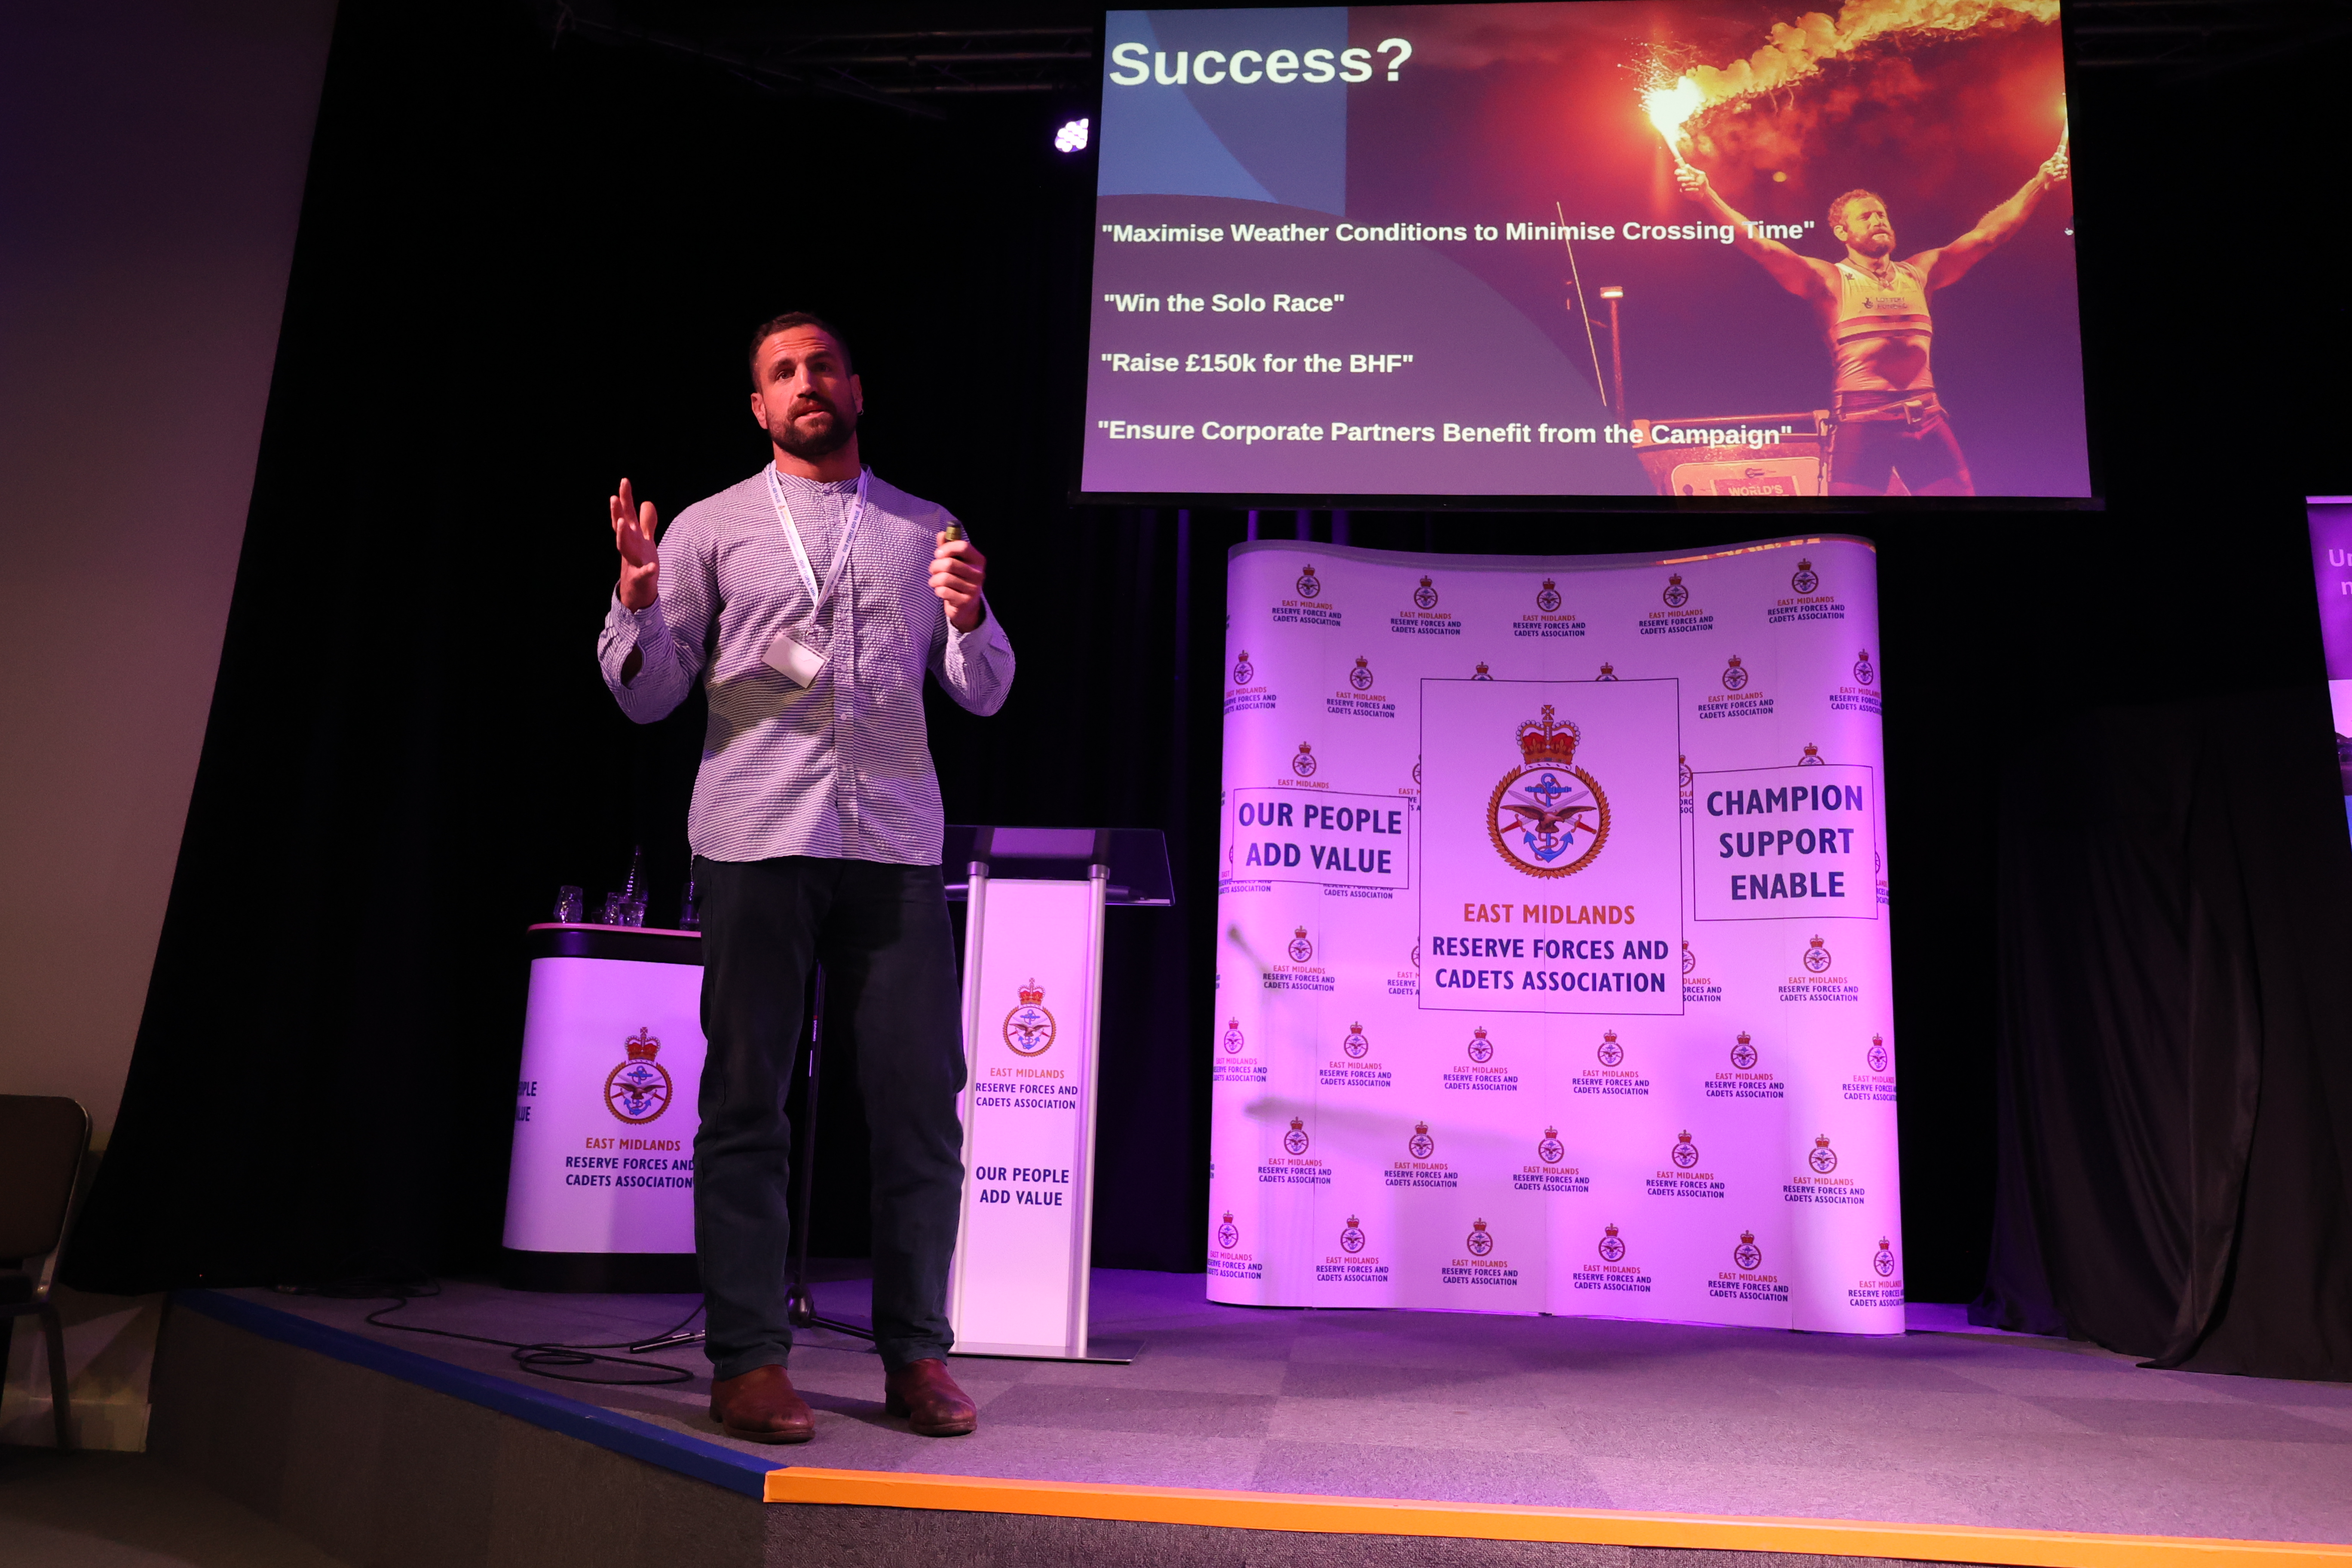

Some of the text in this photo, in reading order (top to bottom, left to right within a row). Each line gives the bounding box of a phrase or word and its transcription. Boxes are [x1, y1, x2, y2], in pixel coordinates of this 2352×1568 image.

[1109, 38, 1411, 85] Success?
[1103, 220, 1813, 244] "Maximise Weather Conditions to Minimise Crossing Time"
[1105, 294, 1344, 311] "Win the Solo Race"
[1102, 353, 1413, 372] "Raise £150k for the BHF"
[1098, 420, 1791, 449] "Ensure Corporate Partners Benefit from the Campaign"
[846, 529, 854, 544] PEOPLE
[803, 570, 812, 586] PEOPLE
[1300, 601, 1332, 609] MIDLANDS
[1767, 606, 1798, 615] RESERVE
[1300, 616, 1340, 626] ASSOCIATION
[1769, 614, 1795, 623] CADETS
[1326, 698, 1354, 707] RESERVE
[1353, 693, 1385, 701] MIDLANDS
[1727, 692, 1763, 700] MIDLANDS
[1730, 700, 1757, 708] FORCES
[1327, 706, 1394, 718] CADETS ASSOCIATION
[1727, 707, 1773, 717] ASSOCIATION
[1707, 784, 1862, 816] CHAMPION
[1239, 802, 1401, 834] OUR PEOPLE
[1719, 828, 1853, 858] SUPPORT
[1246, 842, 1390, 873] ADD VALUE
[1731, 871, 1844, 900] ENABLE
[1464, 903, 1635, 925] EAST MIDLANDS
[1433, 936, 1668, 959] RESERVE FORCES AND
[1262, 972, 1292, 981] RESERVE
[1436, 968, 1664, 992] CADETS ASSOCIATION
[1263, 981, 1333, 991] CADETS ASSOCIATION
[990, 1068, 1064, 1078] EAST MIDLANDS
[976, 1083, 1078, 1094] RESERVE FORCES AND
[976, 1097, 1075, 1109] CADETS ASSOCIATION
[586, 1137, 680, 1151] EAST MIDLANDS
[566, 1156, 695, 1170] RESERVE FORCES AND
[566, 1174, 692, 1188] CADETS ASSOCIATION
[976, 1166, 1069, 1183] OUR PEOPLE
[1782, 1185, 1815, 1193] RESERVE
[980, 1189, 1062, 1205] ADD VALUE
[1815, 1195, 1864, 1204] ASSOCIATION
[1603, 1265, 1640, 1274] MIDLANDS
[1603, 1283, 1650, 1292] ASSOCIATION
